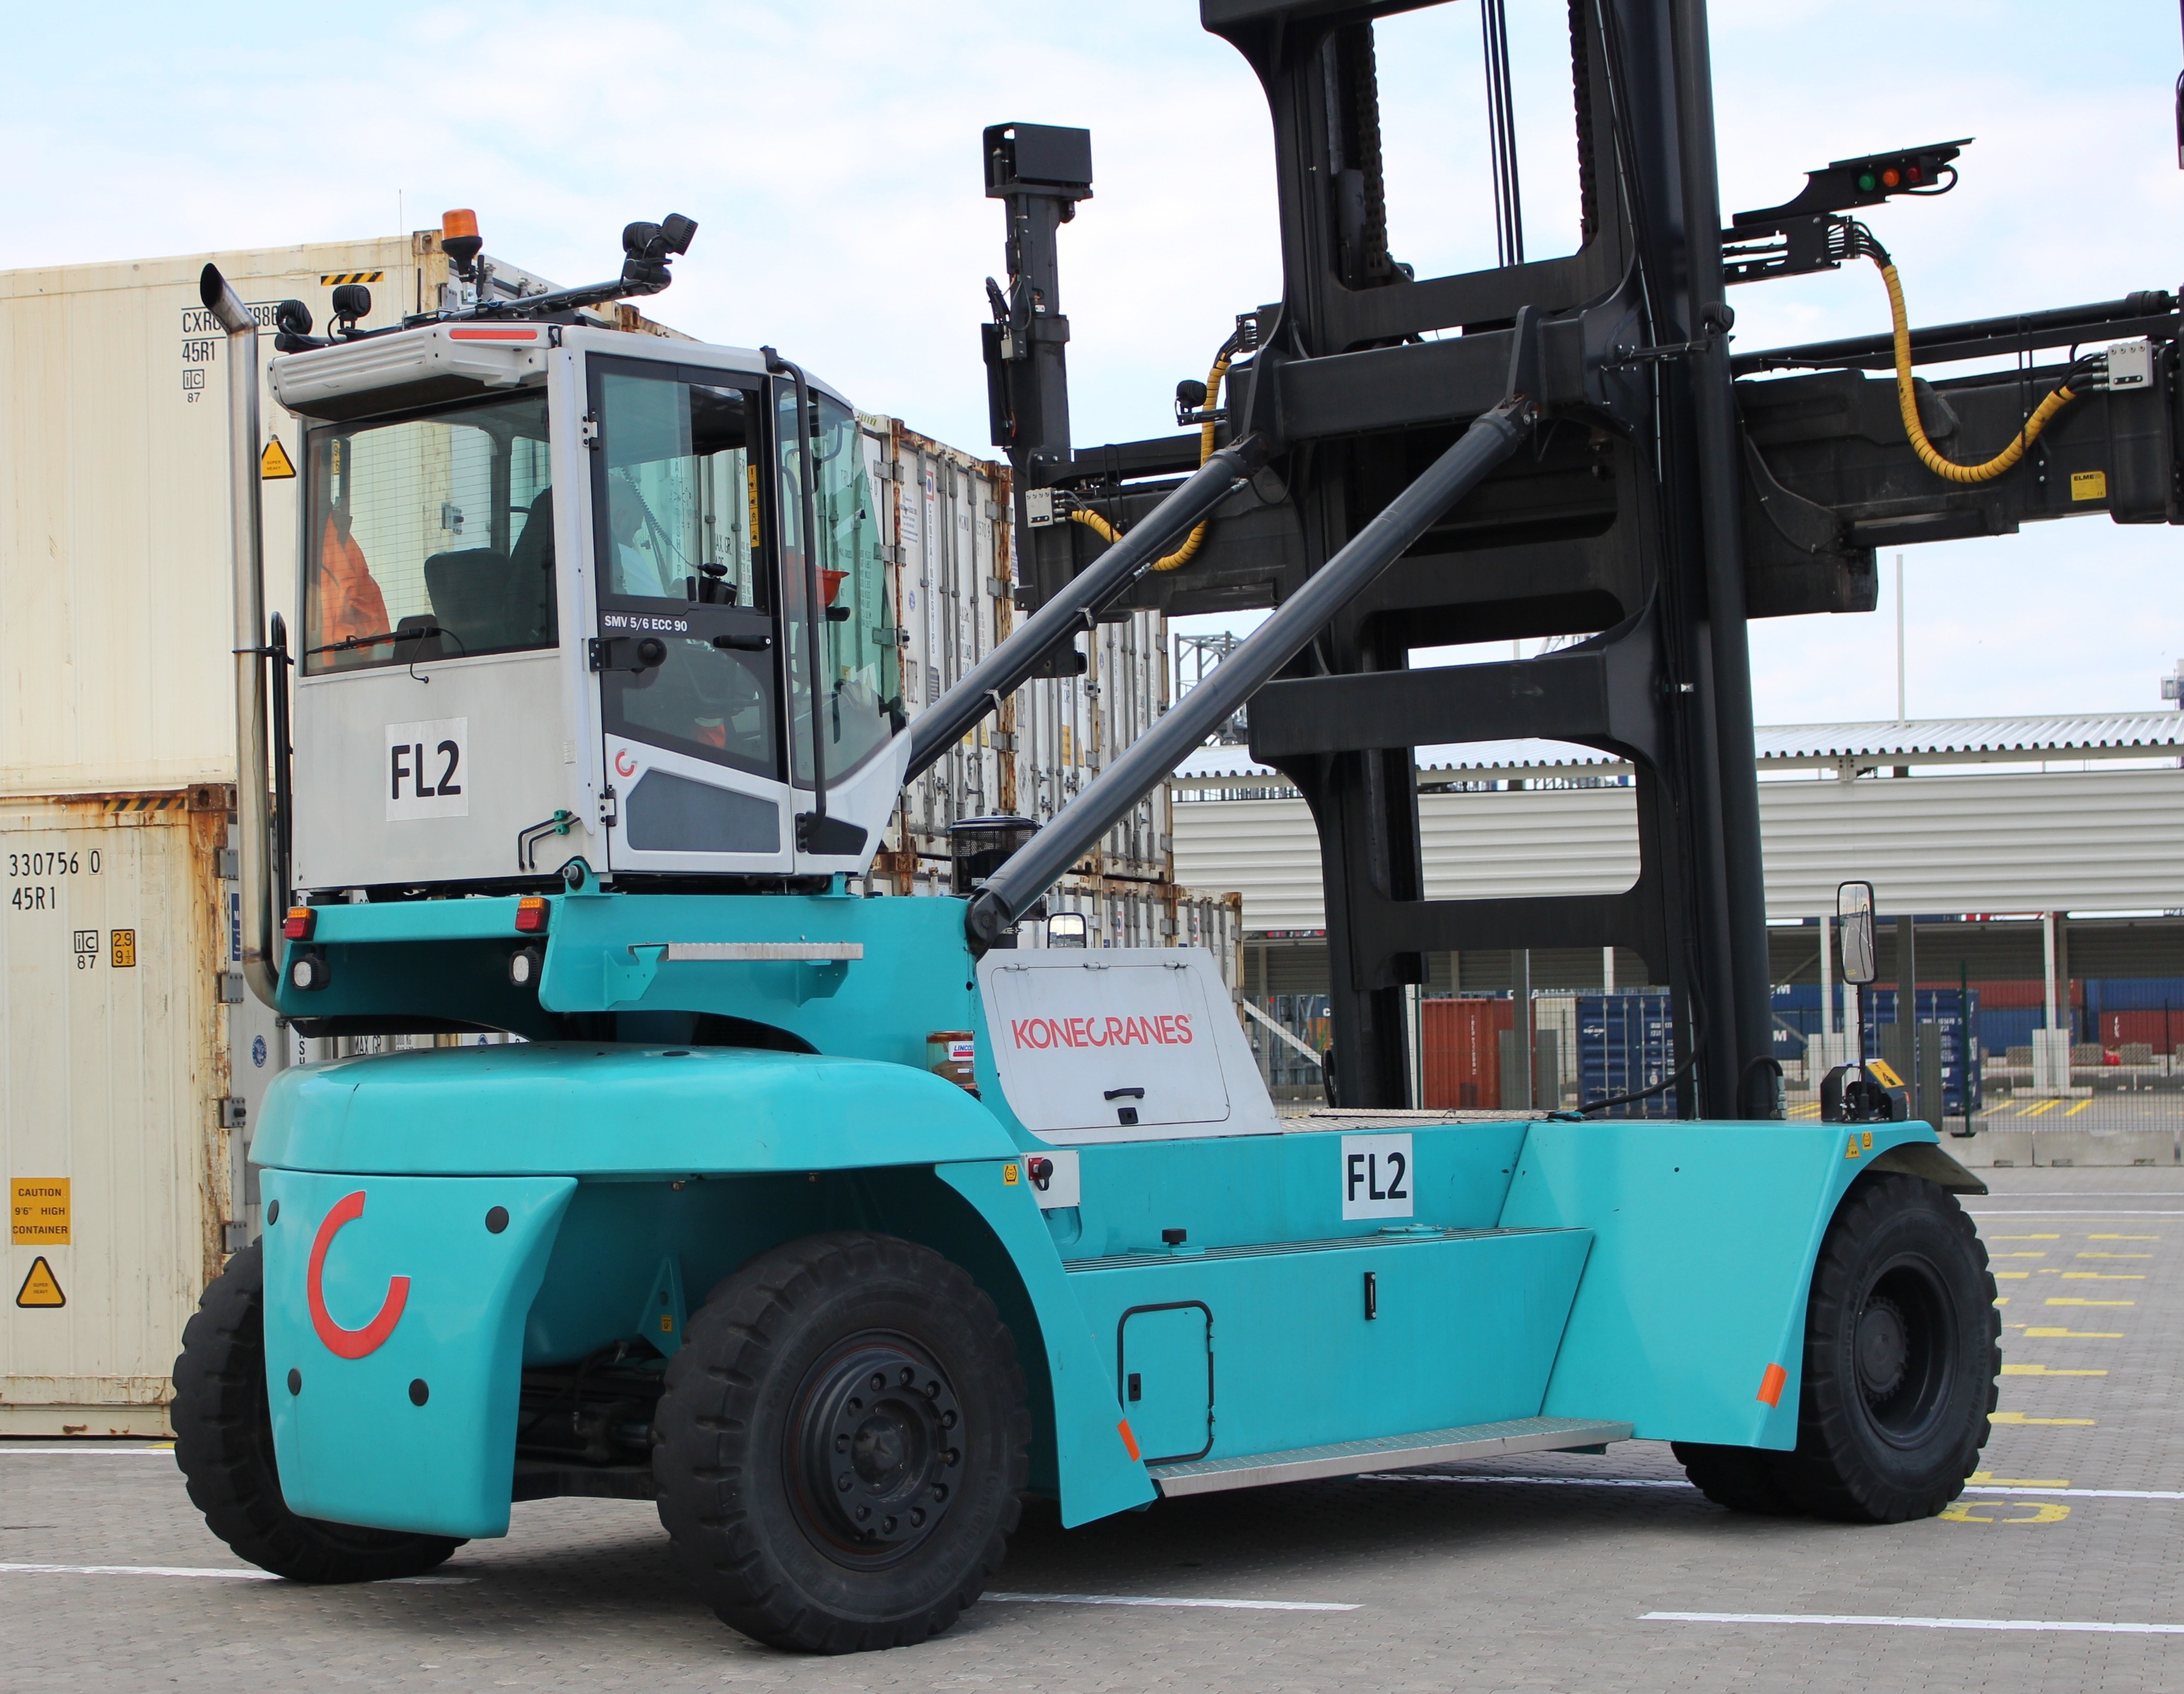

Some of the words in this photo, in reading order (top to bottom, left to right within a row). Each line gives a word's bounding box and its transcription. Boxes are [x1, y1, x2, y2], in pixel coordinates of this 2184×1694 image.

[182, 341, 215, 362] 45R1
[187, 392, 201, 403] 87
[604, 615, 627, 628] SMV
[630, 617, 649, 631] 5/6
[651, 618, 672, 631] ECC
[674, 620, 688, 632] 90
[391, 740, 461, 800] FL2
[9, 851, 79, 877] 330756
[90, 850, 100, 874] 0
[12, 886, 56, 911] 45R1
[77, 954, 97, 970] 87
[1347, 1152, 1407, 1202] FL2
[18, 1188, 62, 1197] CAUTION
[41, 1207, 65, 1216] HIGH
[13, 1226, 68, 1234] CONTAINER
